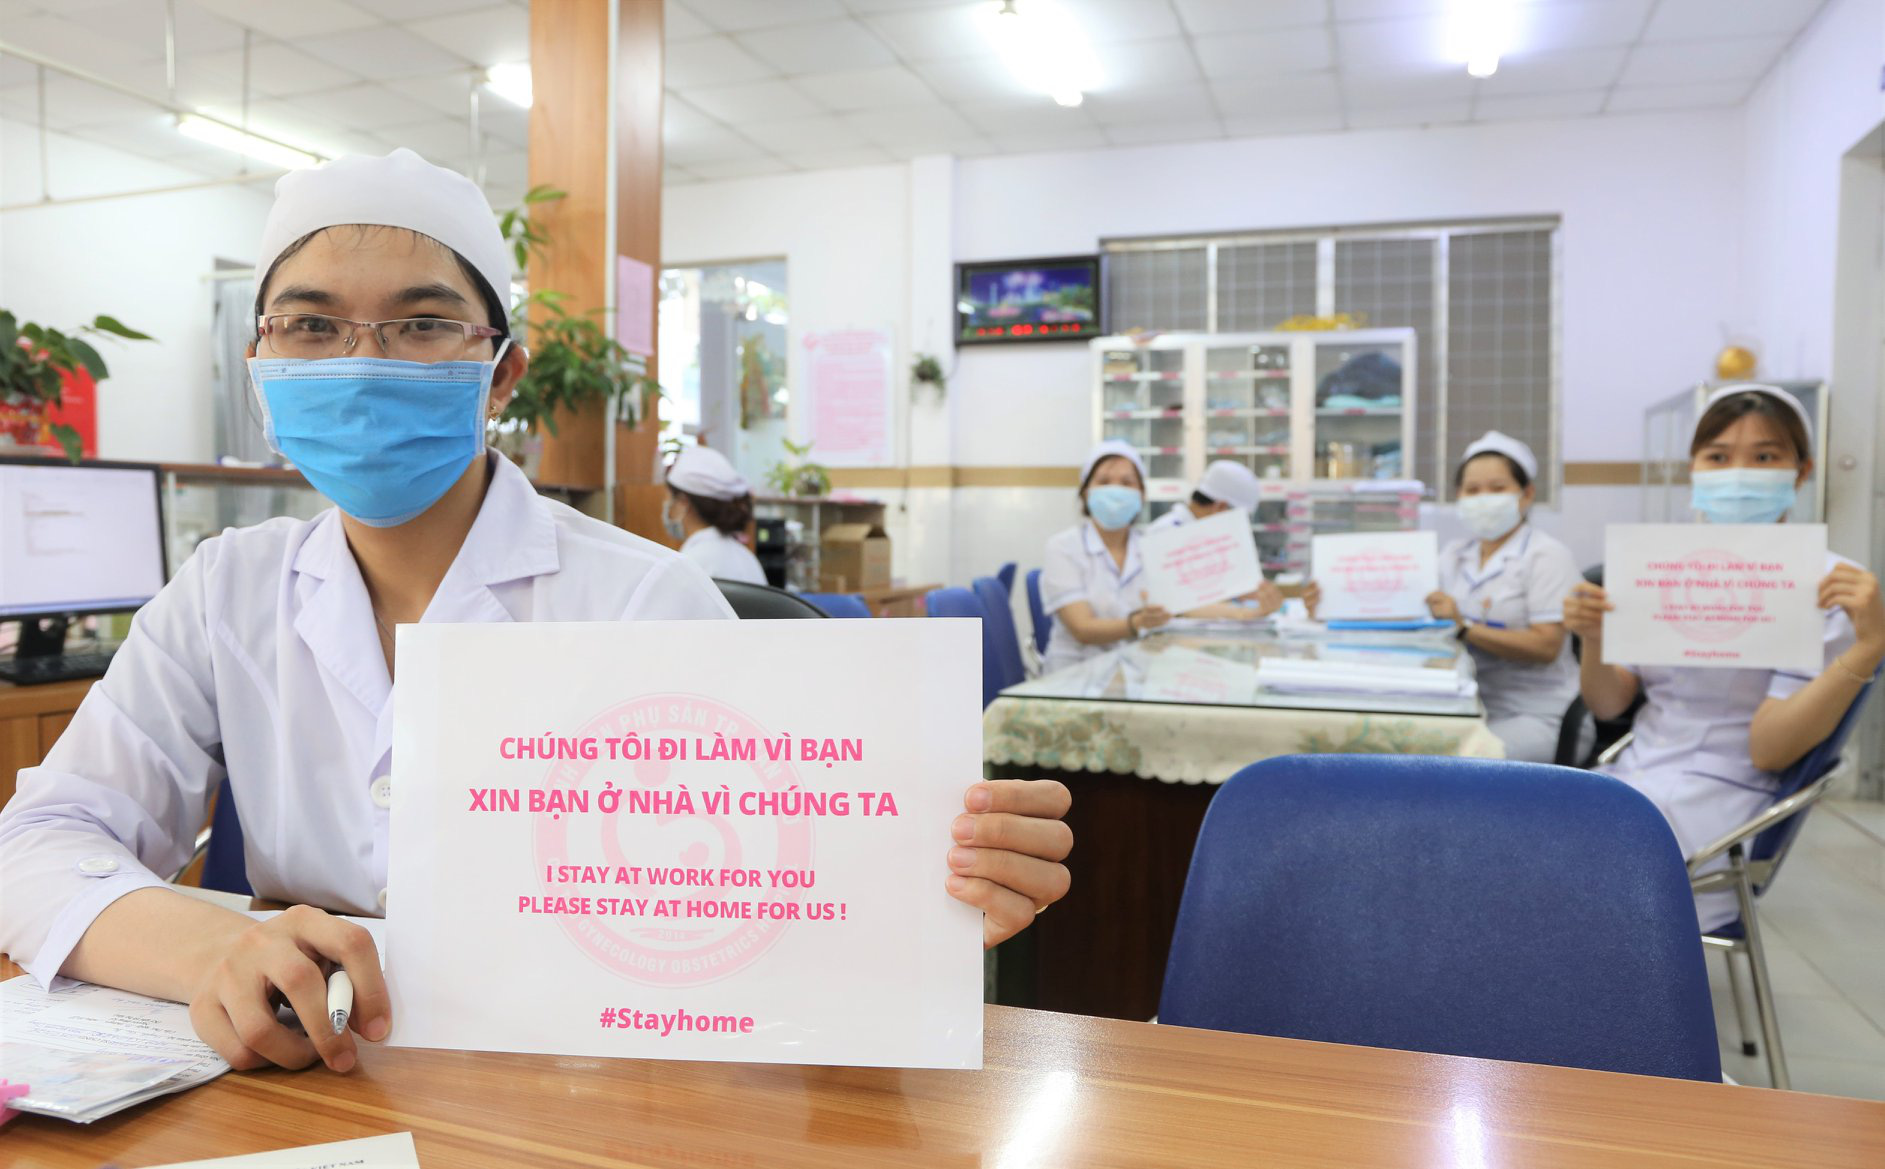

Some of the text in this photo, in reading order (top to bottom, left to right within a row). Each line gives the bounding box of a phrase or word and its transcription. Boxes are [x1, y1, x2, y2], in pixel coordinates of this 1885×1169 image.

[500, 731, 598, 760] CHÚNG
[605, 731, 651, 760] TÔI
[658, 738, 687, 761] ĐI
[695, 731, 756, 761] LÀM
[764, 732, 791, 761] VÌ
[801, 738, 863, 769] BẠN
[469, 788, 519, 812] XIN
[529, 789, 589, 820] BẠN
[598, 781, 623, 814] Ở
[629, 784, 695, 815] NHÀ
[702, 784, 730, 815] VÌ
[739, 785, 849, 816] CHÚNG
[858, 792, 898, 817] TA
[547, 865, 815, 889] I STAY AT WORK FOR YOU
[518, 896, 847, 921] PLEASE STAY AT HOME FOR US !
[671, 928, 761, 974] OBSTETRICS
[600, 1007, 754, 1038] #Stayhome
